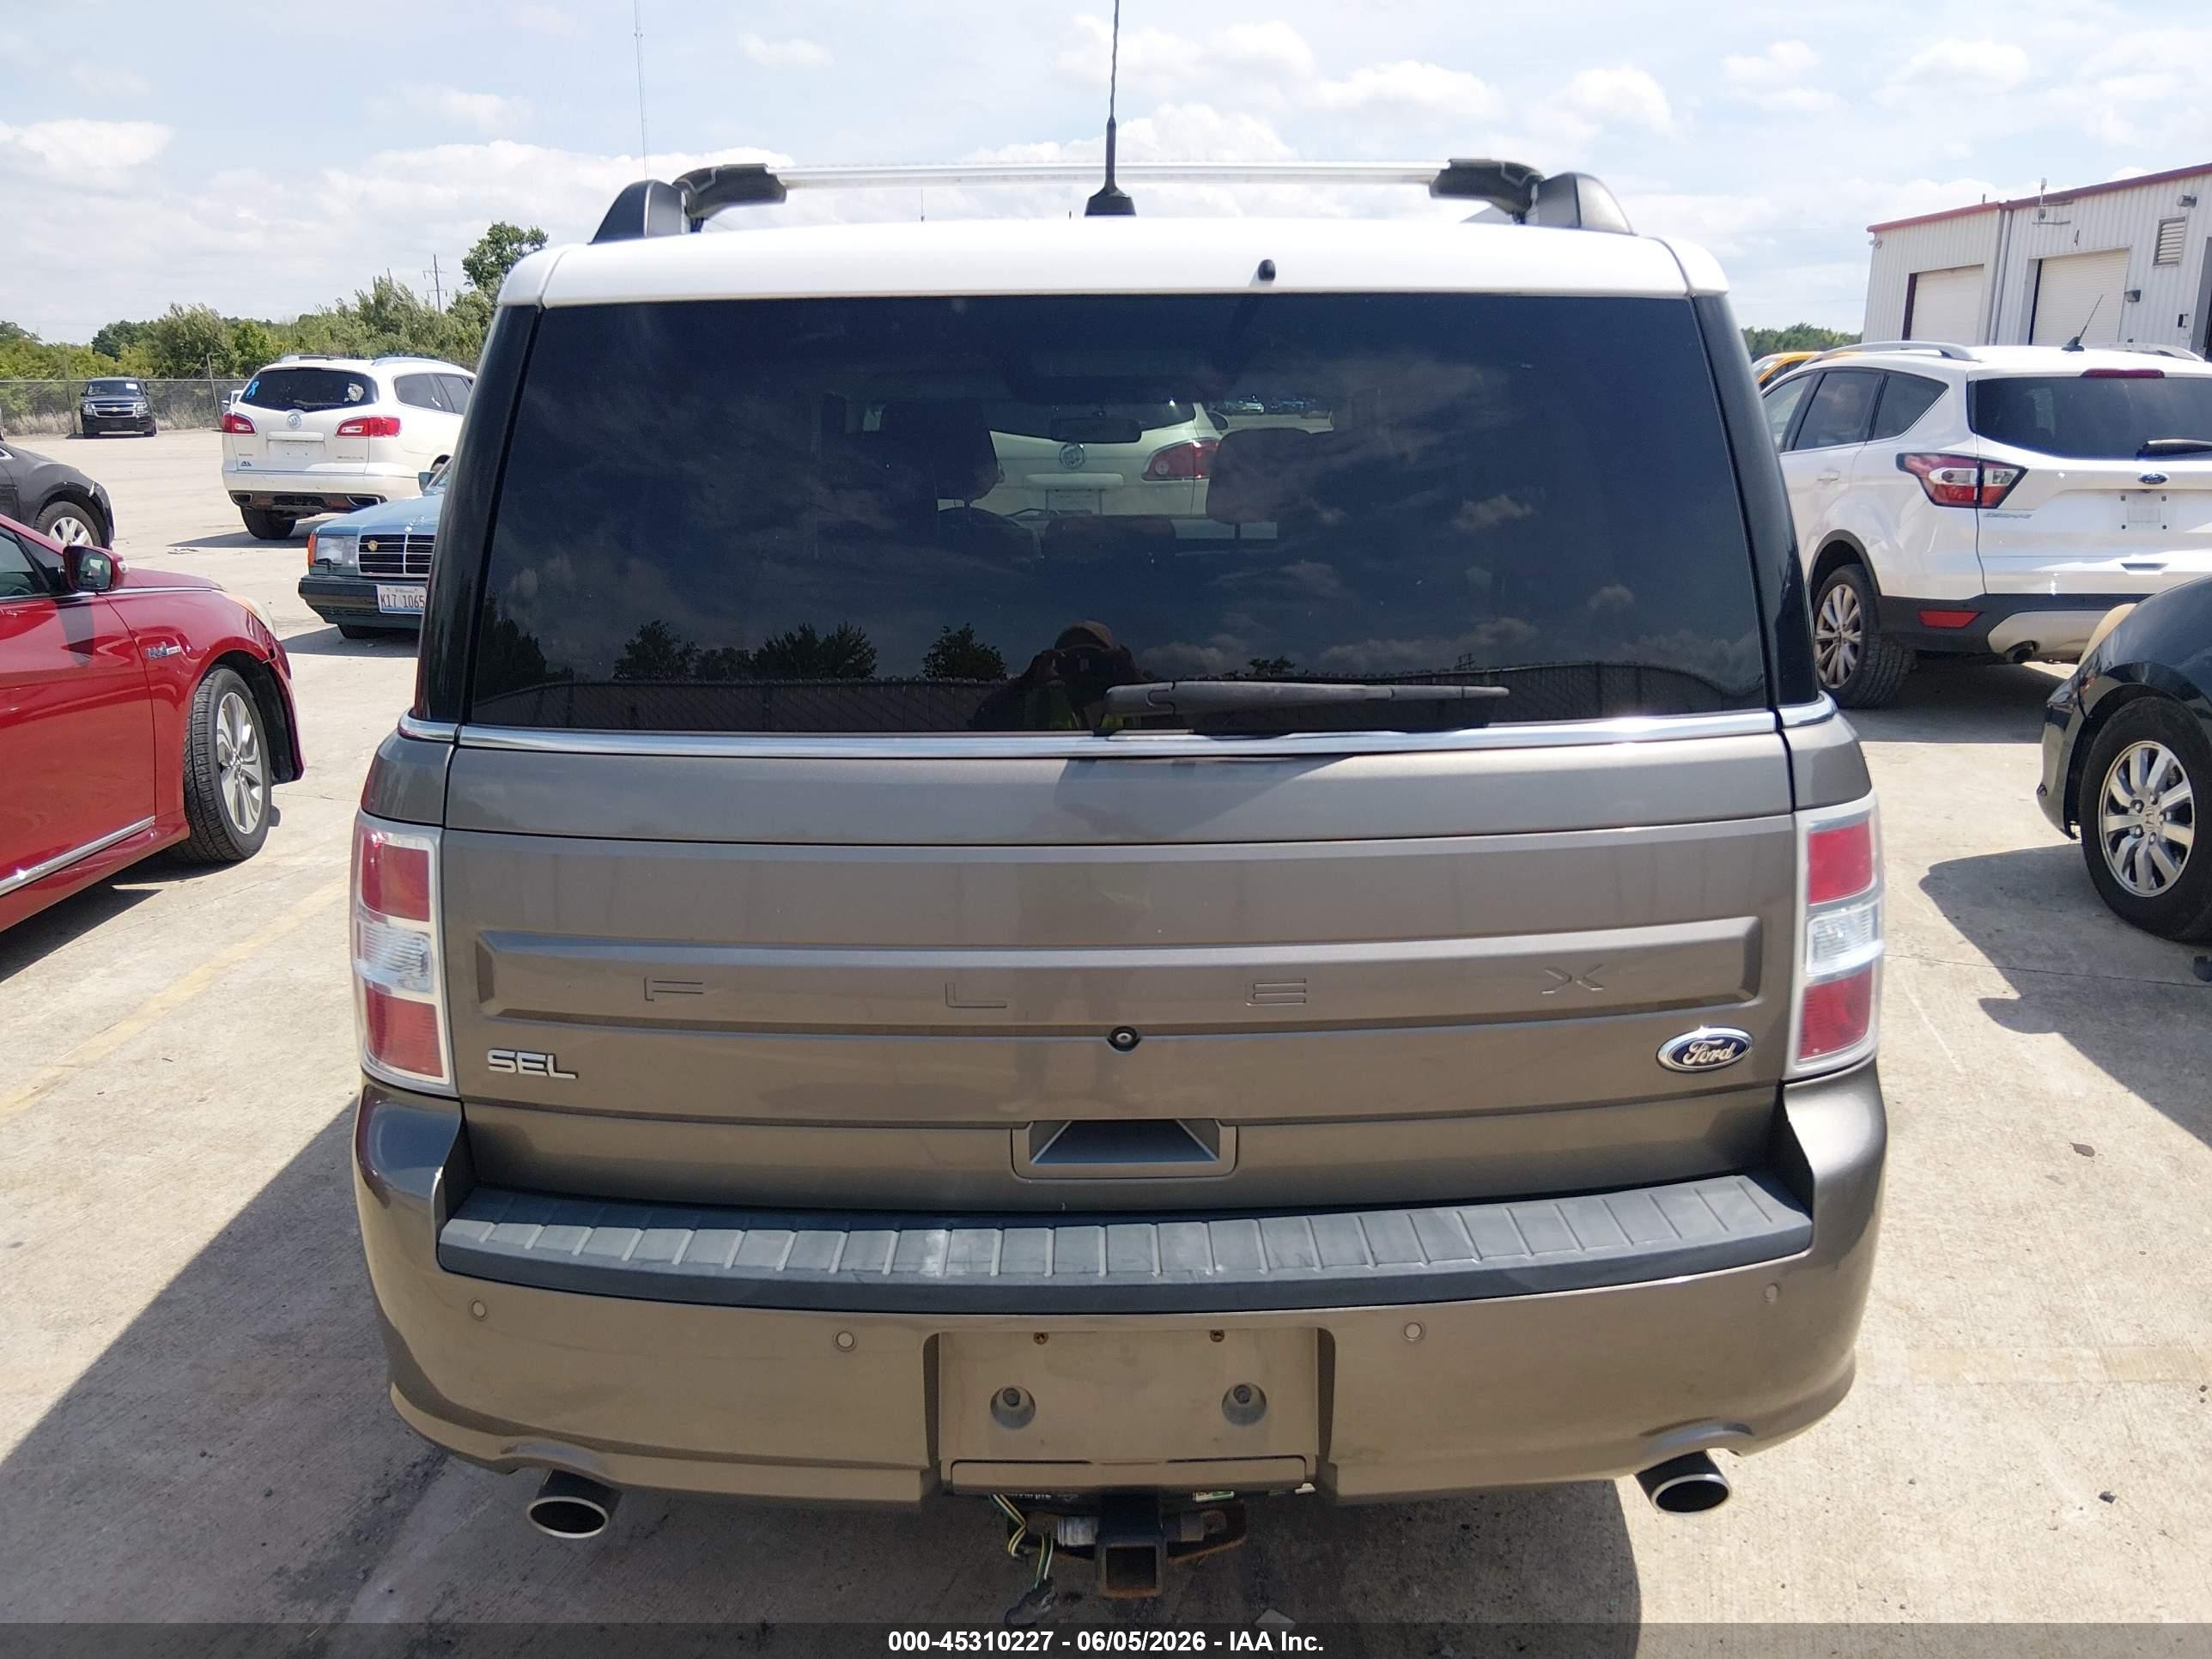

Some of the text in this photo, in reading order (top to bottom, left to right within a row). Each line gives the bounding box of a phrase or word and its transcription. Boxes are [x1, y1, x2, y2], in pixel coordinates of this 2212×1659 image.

[380, 594, 425, 609] K17 1065
[643, 963, 1604, 1009] FLEX
[487, 1048, 579, 1079] SEL
[1682, 1038, 1737, 1066] Ford
